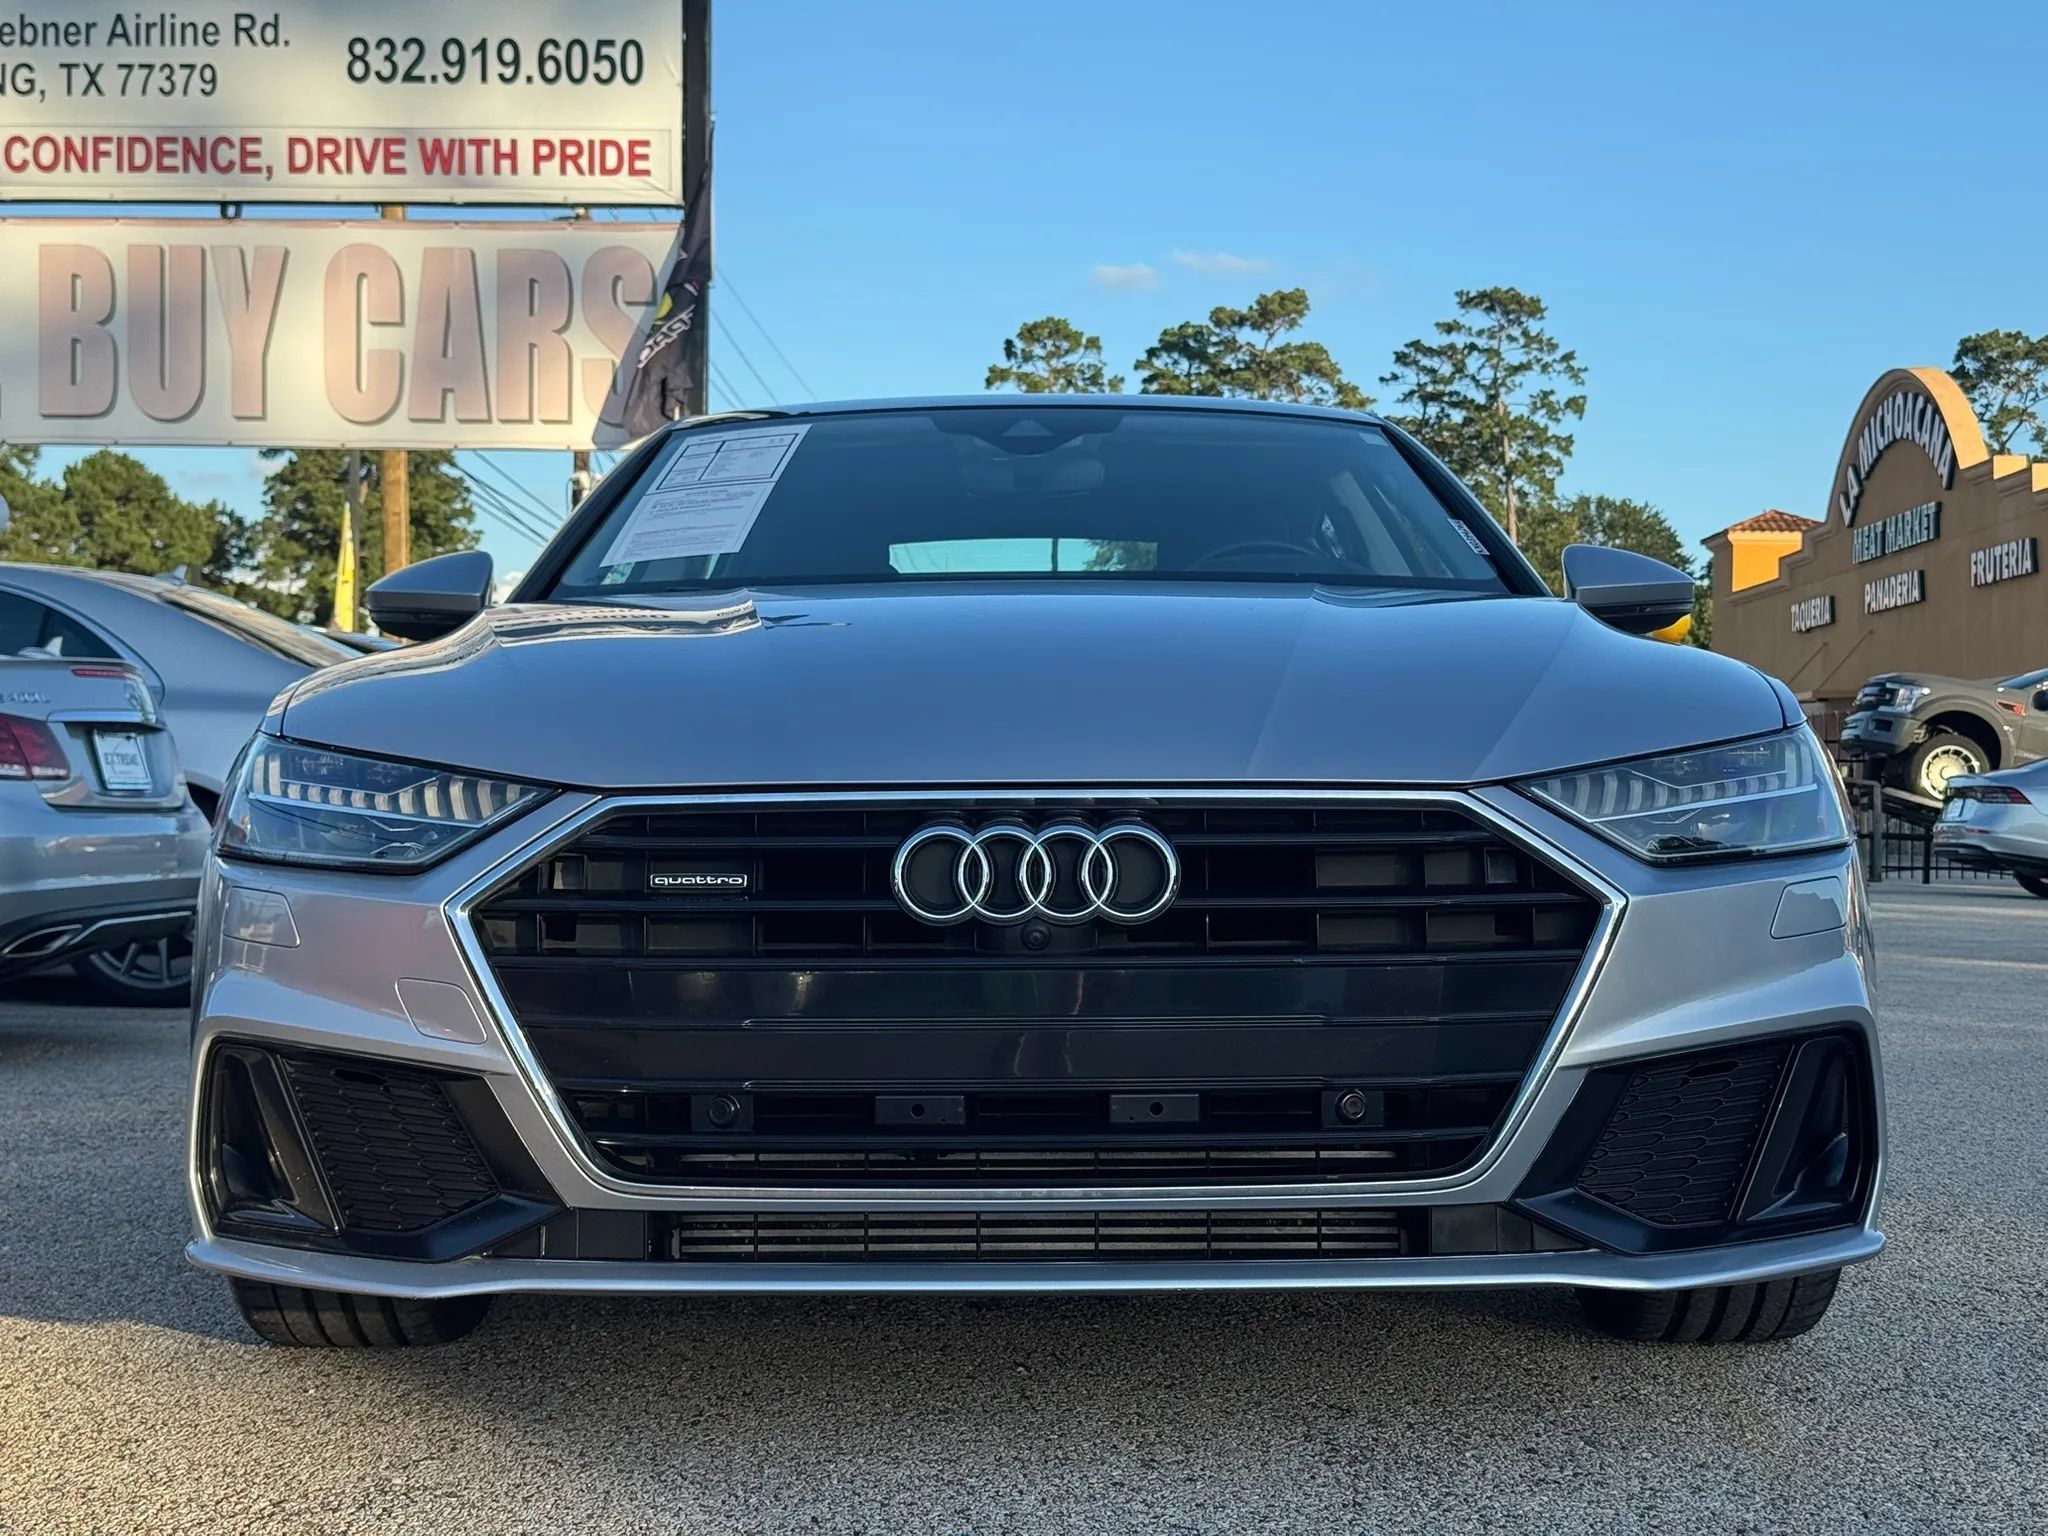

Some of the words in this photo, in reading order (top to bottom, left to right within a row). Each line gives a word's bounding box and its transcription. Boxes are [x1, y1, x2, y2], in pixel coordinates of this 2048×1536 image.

[106, 13, 220, 47] Airline
[233, 14, 290, 48] Rd.
[59, 62, 105, 97] TX
[117, 63, 218, 97] 77379
[346, 38, 644, 87] 832.919.6050
[4, 135, 274, 181] CONFIDENCE,
[288, 137, 407, 176] DRIVE
[419, 138, 519, 177] WITH
[532, 139, 652, 178] PRIDE
[38, 244, 290, 421] BUY
[323, 244, 658, 425] CARS
[1839, 464, 1862, 528] LA
[1858, 391, 1954, 491] MICHOACANA
[1852, 519, 1884, 565] MEAT
[1885, 501, 1937, 554] MARKET
[1970, 537, 2034, 588] FRUTERIA
[1790, 595, 1832, 632] TAQUERIA
[1864, 569, 1922, 615] PANADERIA
[654, 875, 743, 886] quattro
